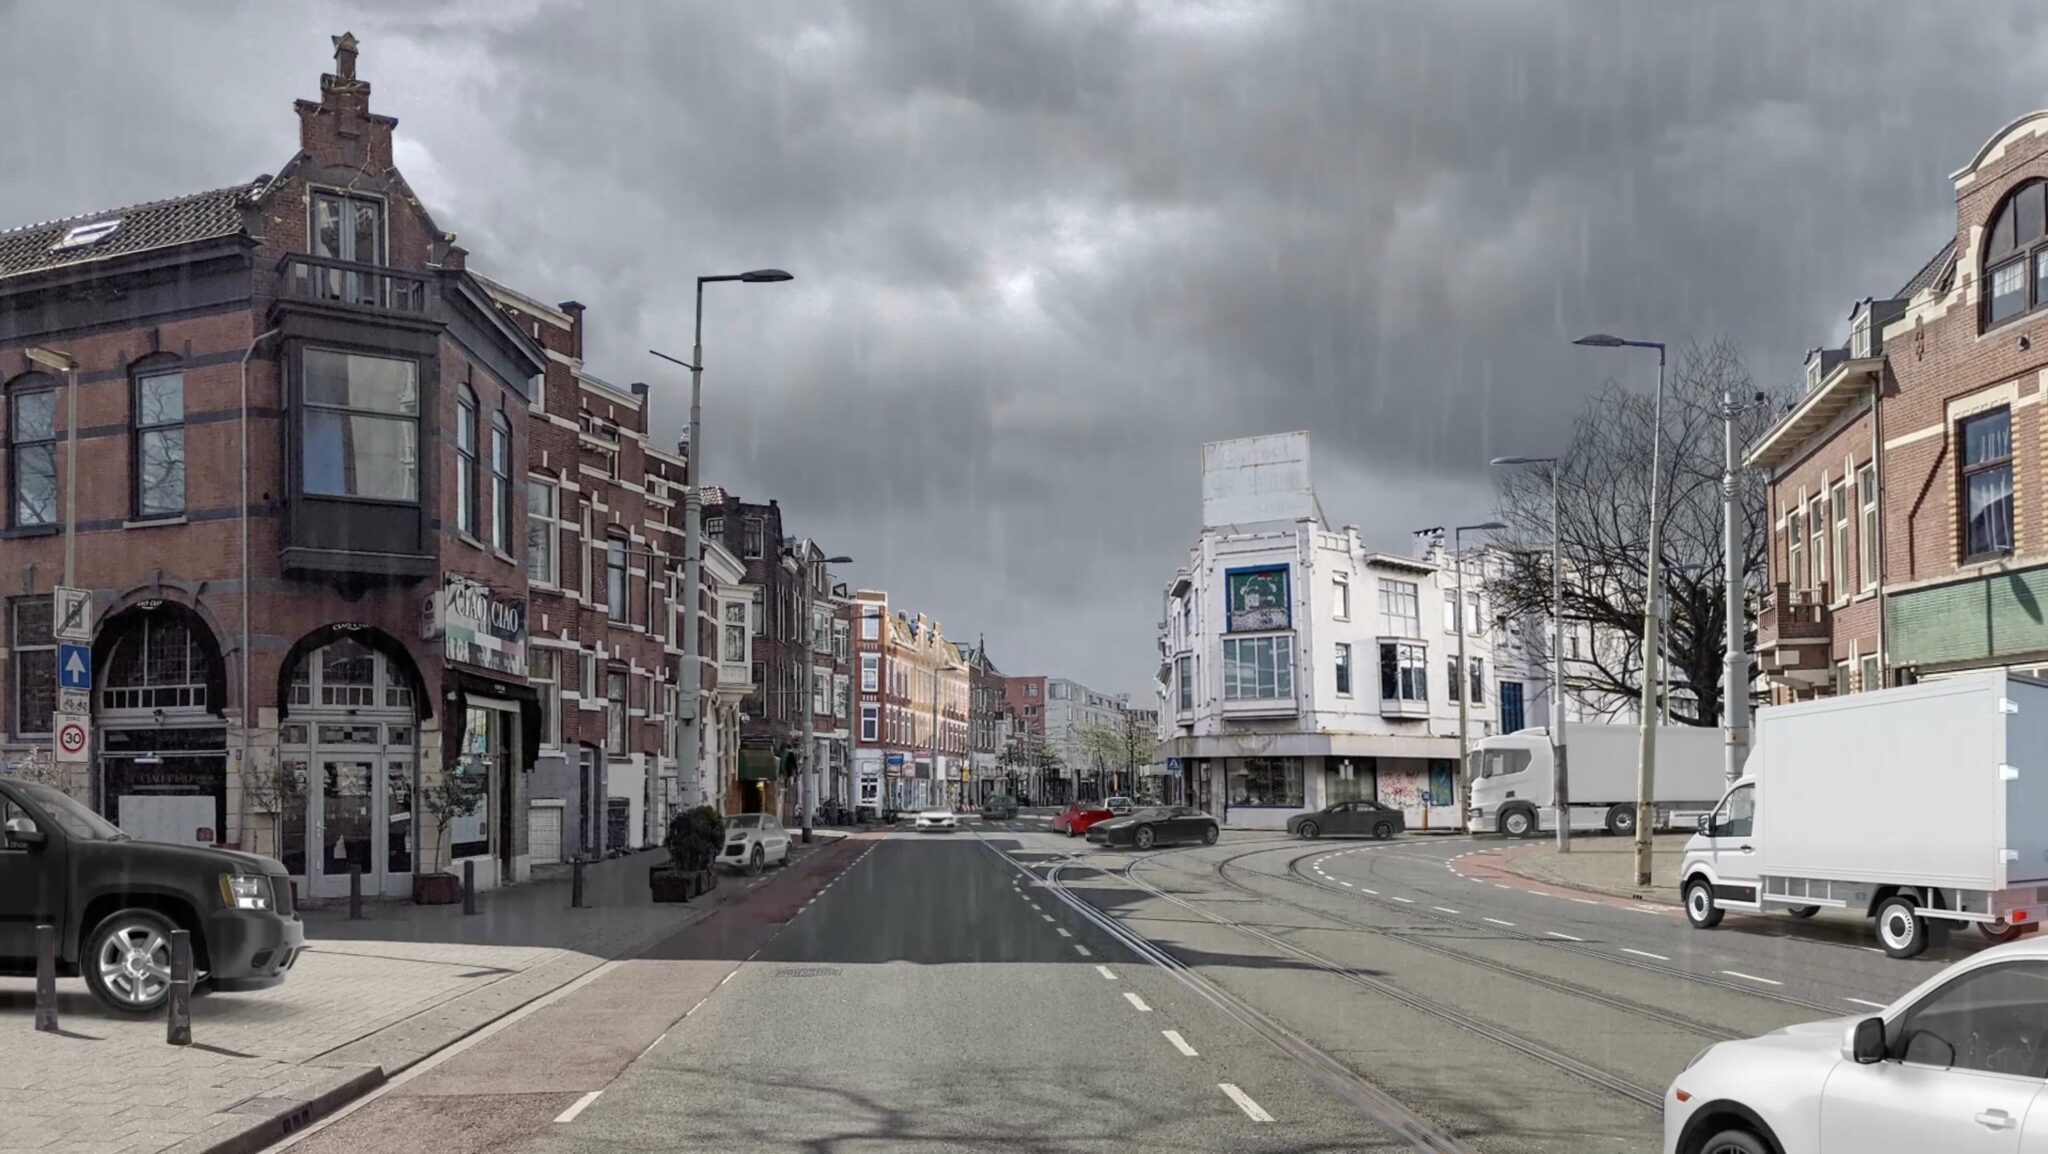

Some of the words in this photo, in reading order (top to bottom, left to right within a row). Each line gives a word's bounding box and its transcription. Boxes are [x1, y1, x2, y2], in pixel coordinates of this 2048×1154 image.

[456, 588, 488, 622] CIAO
[491, 601, 518, 633] CIAO
[65, 732, 82, 745] 30
